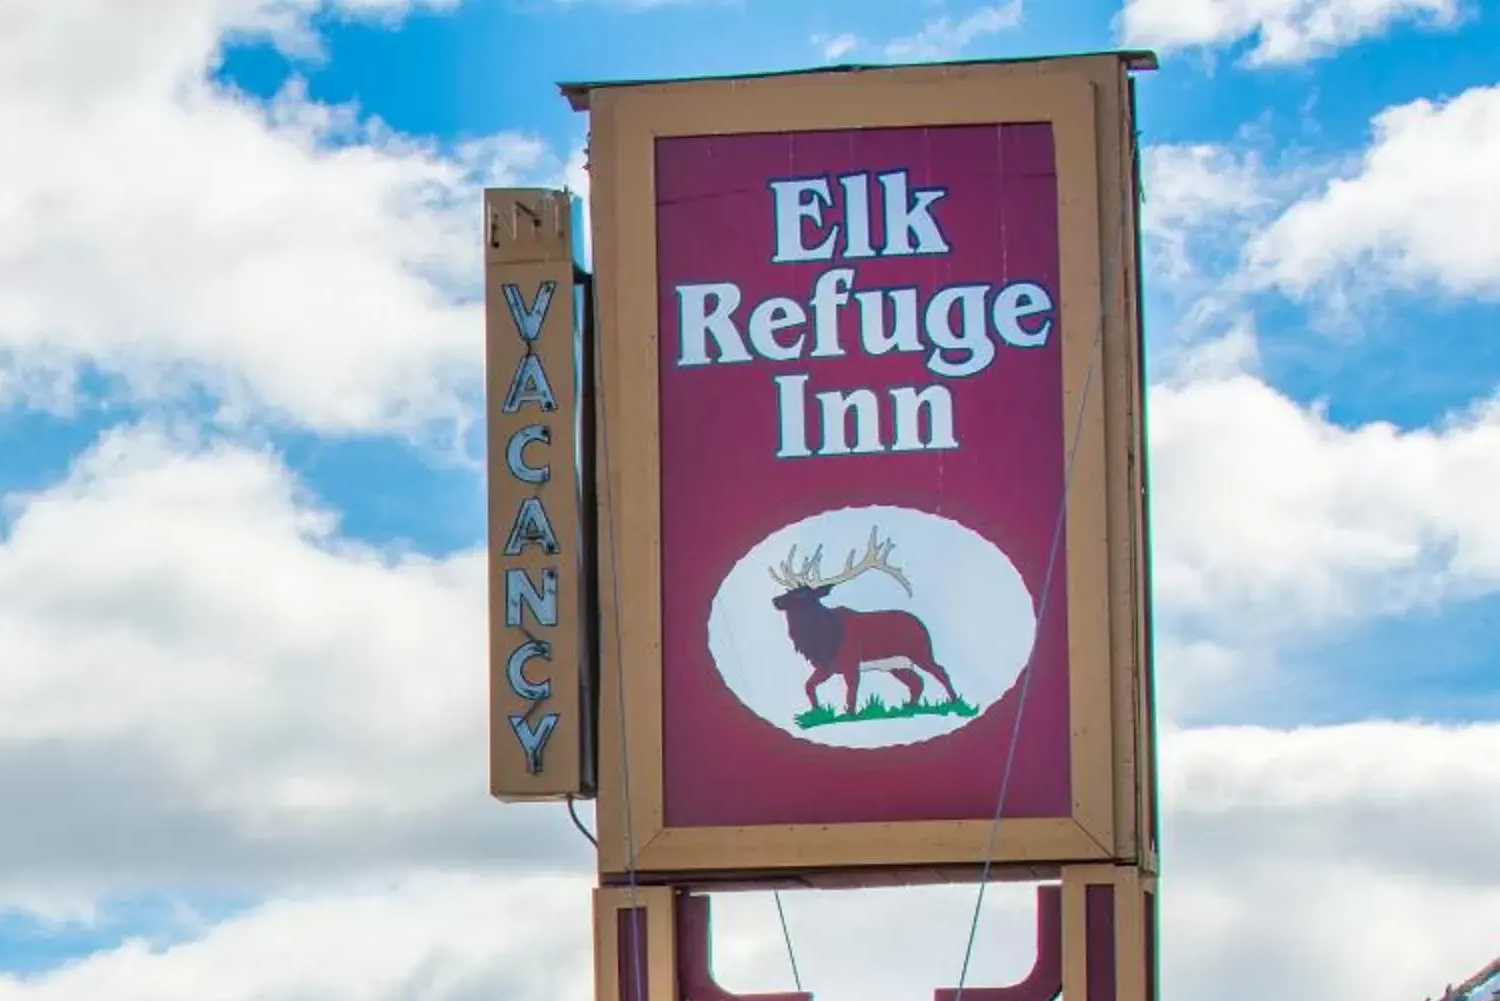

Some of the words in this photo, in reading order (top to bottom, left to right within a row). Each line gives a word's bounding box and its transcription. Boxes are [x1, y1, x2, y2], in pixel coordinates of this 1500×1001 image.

[769, 168, 951, 263] Elk
[675, 268, 1053, 377] Refuge
[775, 373, 959, 458] Inn
[502, 280, 559, 775] VACANCY
